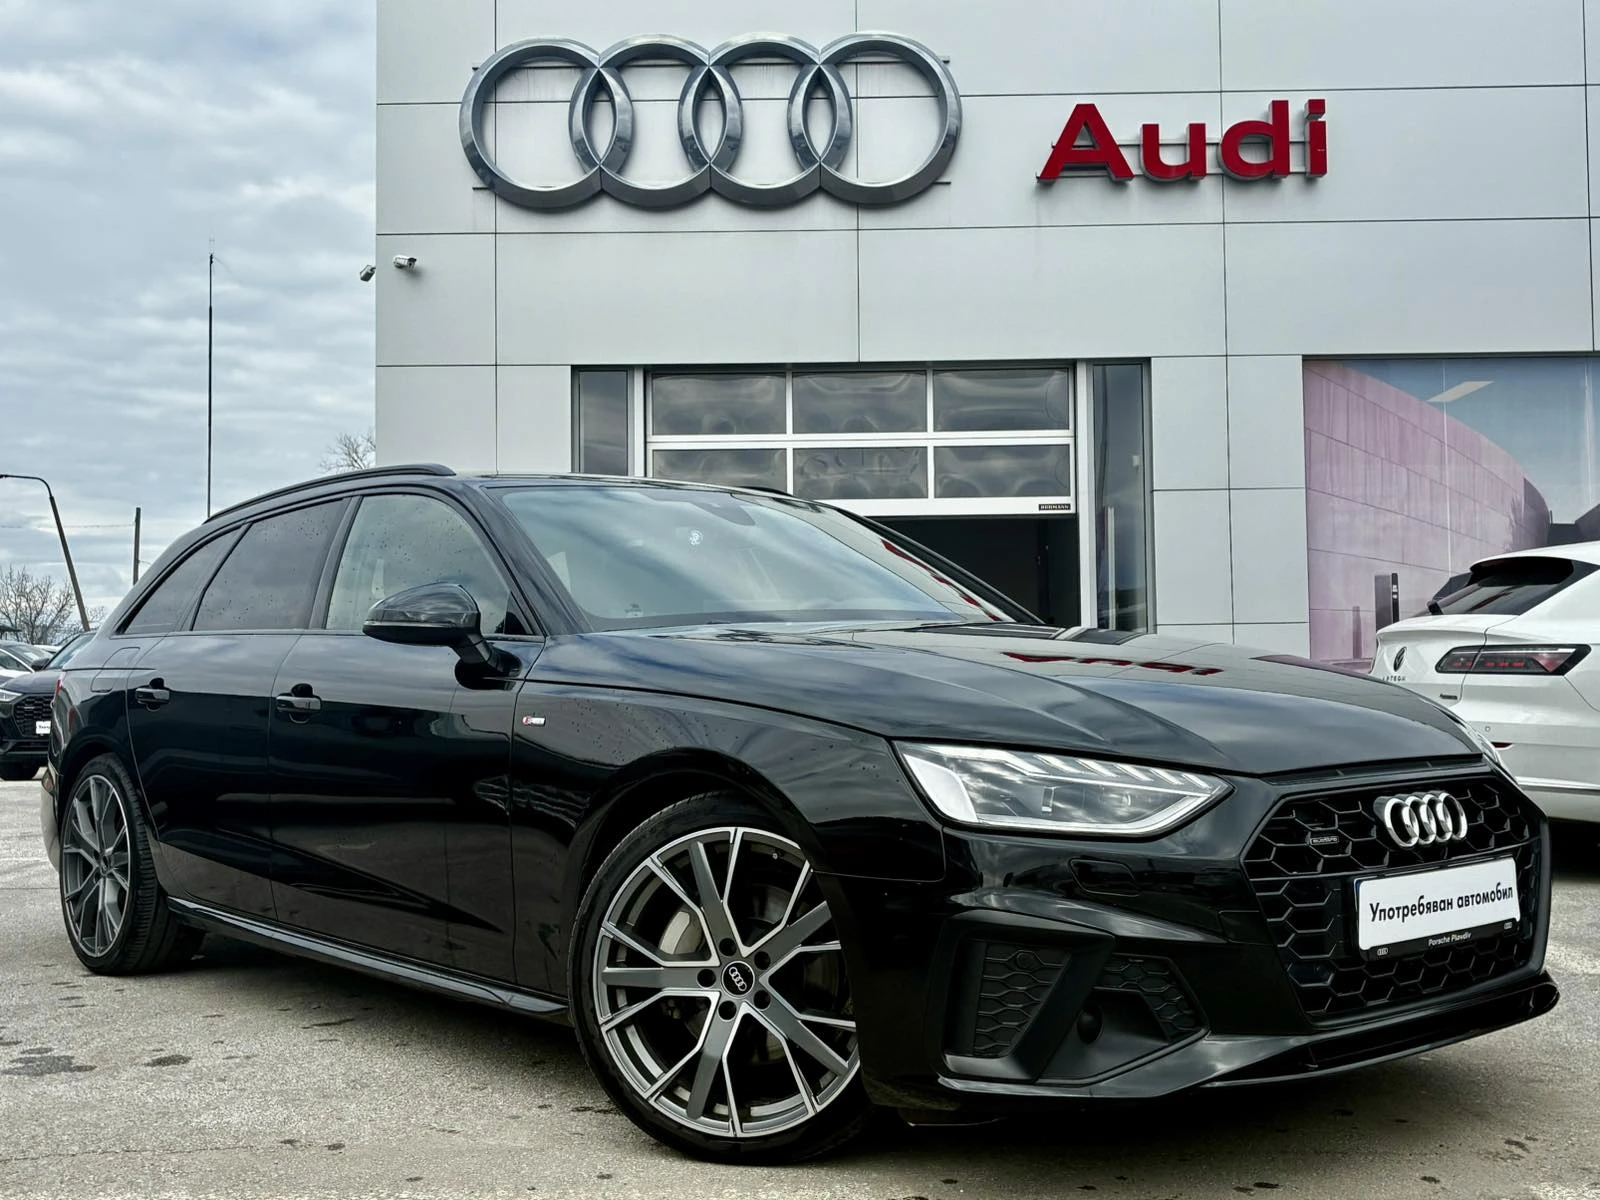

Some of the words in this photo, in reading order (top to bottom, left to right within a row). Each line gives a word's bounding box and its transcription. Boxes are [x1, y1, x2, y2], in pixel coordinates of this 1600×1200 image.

[1038, 98, 1328, 181] Audi
[1369, 895, 1453, 922] Употребяван
[1457, 882, 1513, 909] автомобил
[1428, 935, 1450, 946] Porsche
